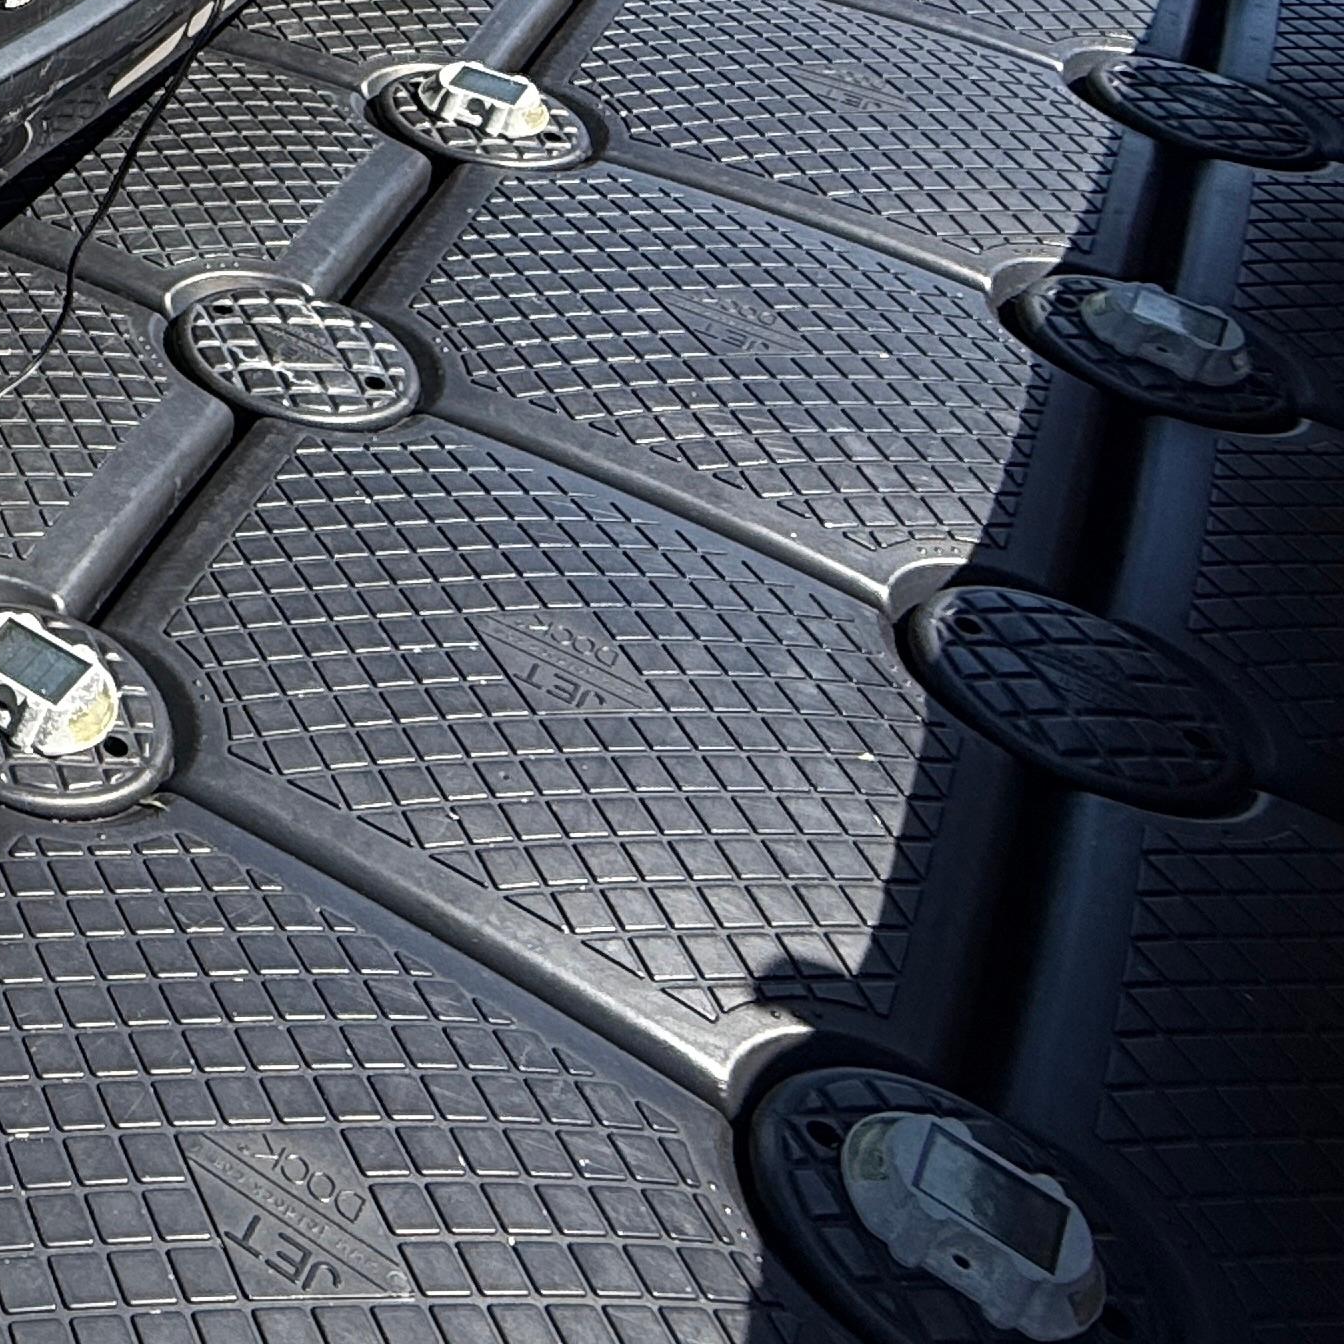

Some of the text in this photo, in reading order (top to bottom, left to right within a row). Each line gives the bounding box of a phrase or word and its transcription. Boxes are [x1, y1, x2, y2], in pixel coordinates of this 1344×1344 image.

[512, 663, 606, 708] JET
[254, 1133, 366, 1224] DOCK
[223, 1215, 342, 1291] JET
